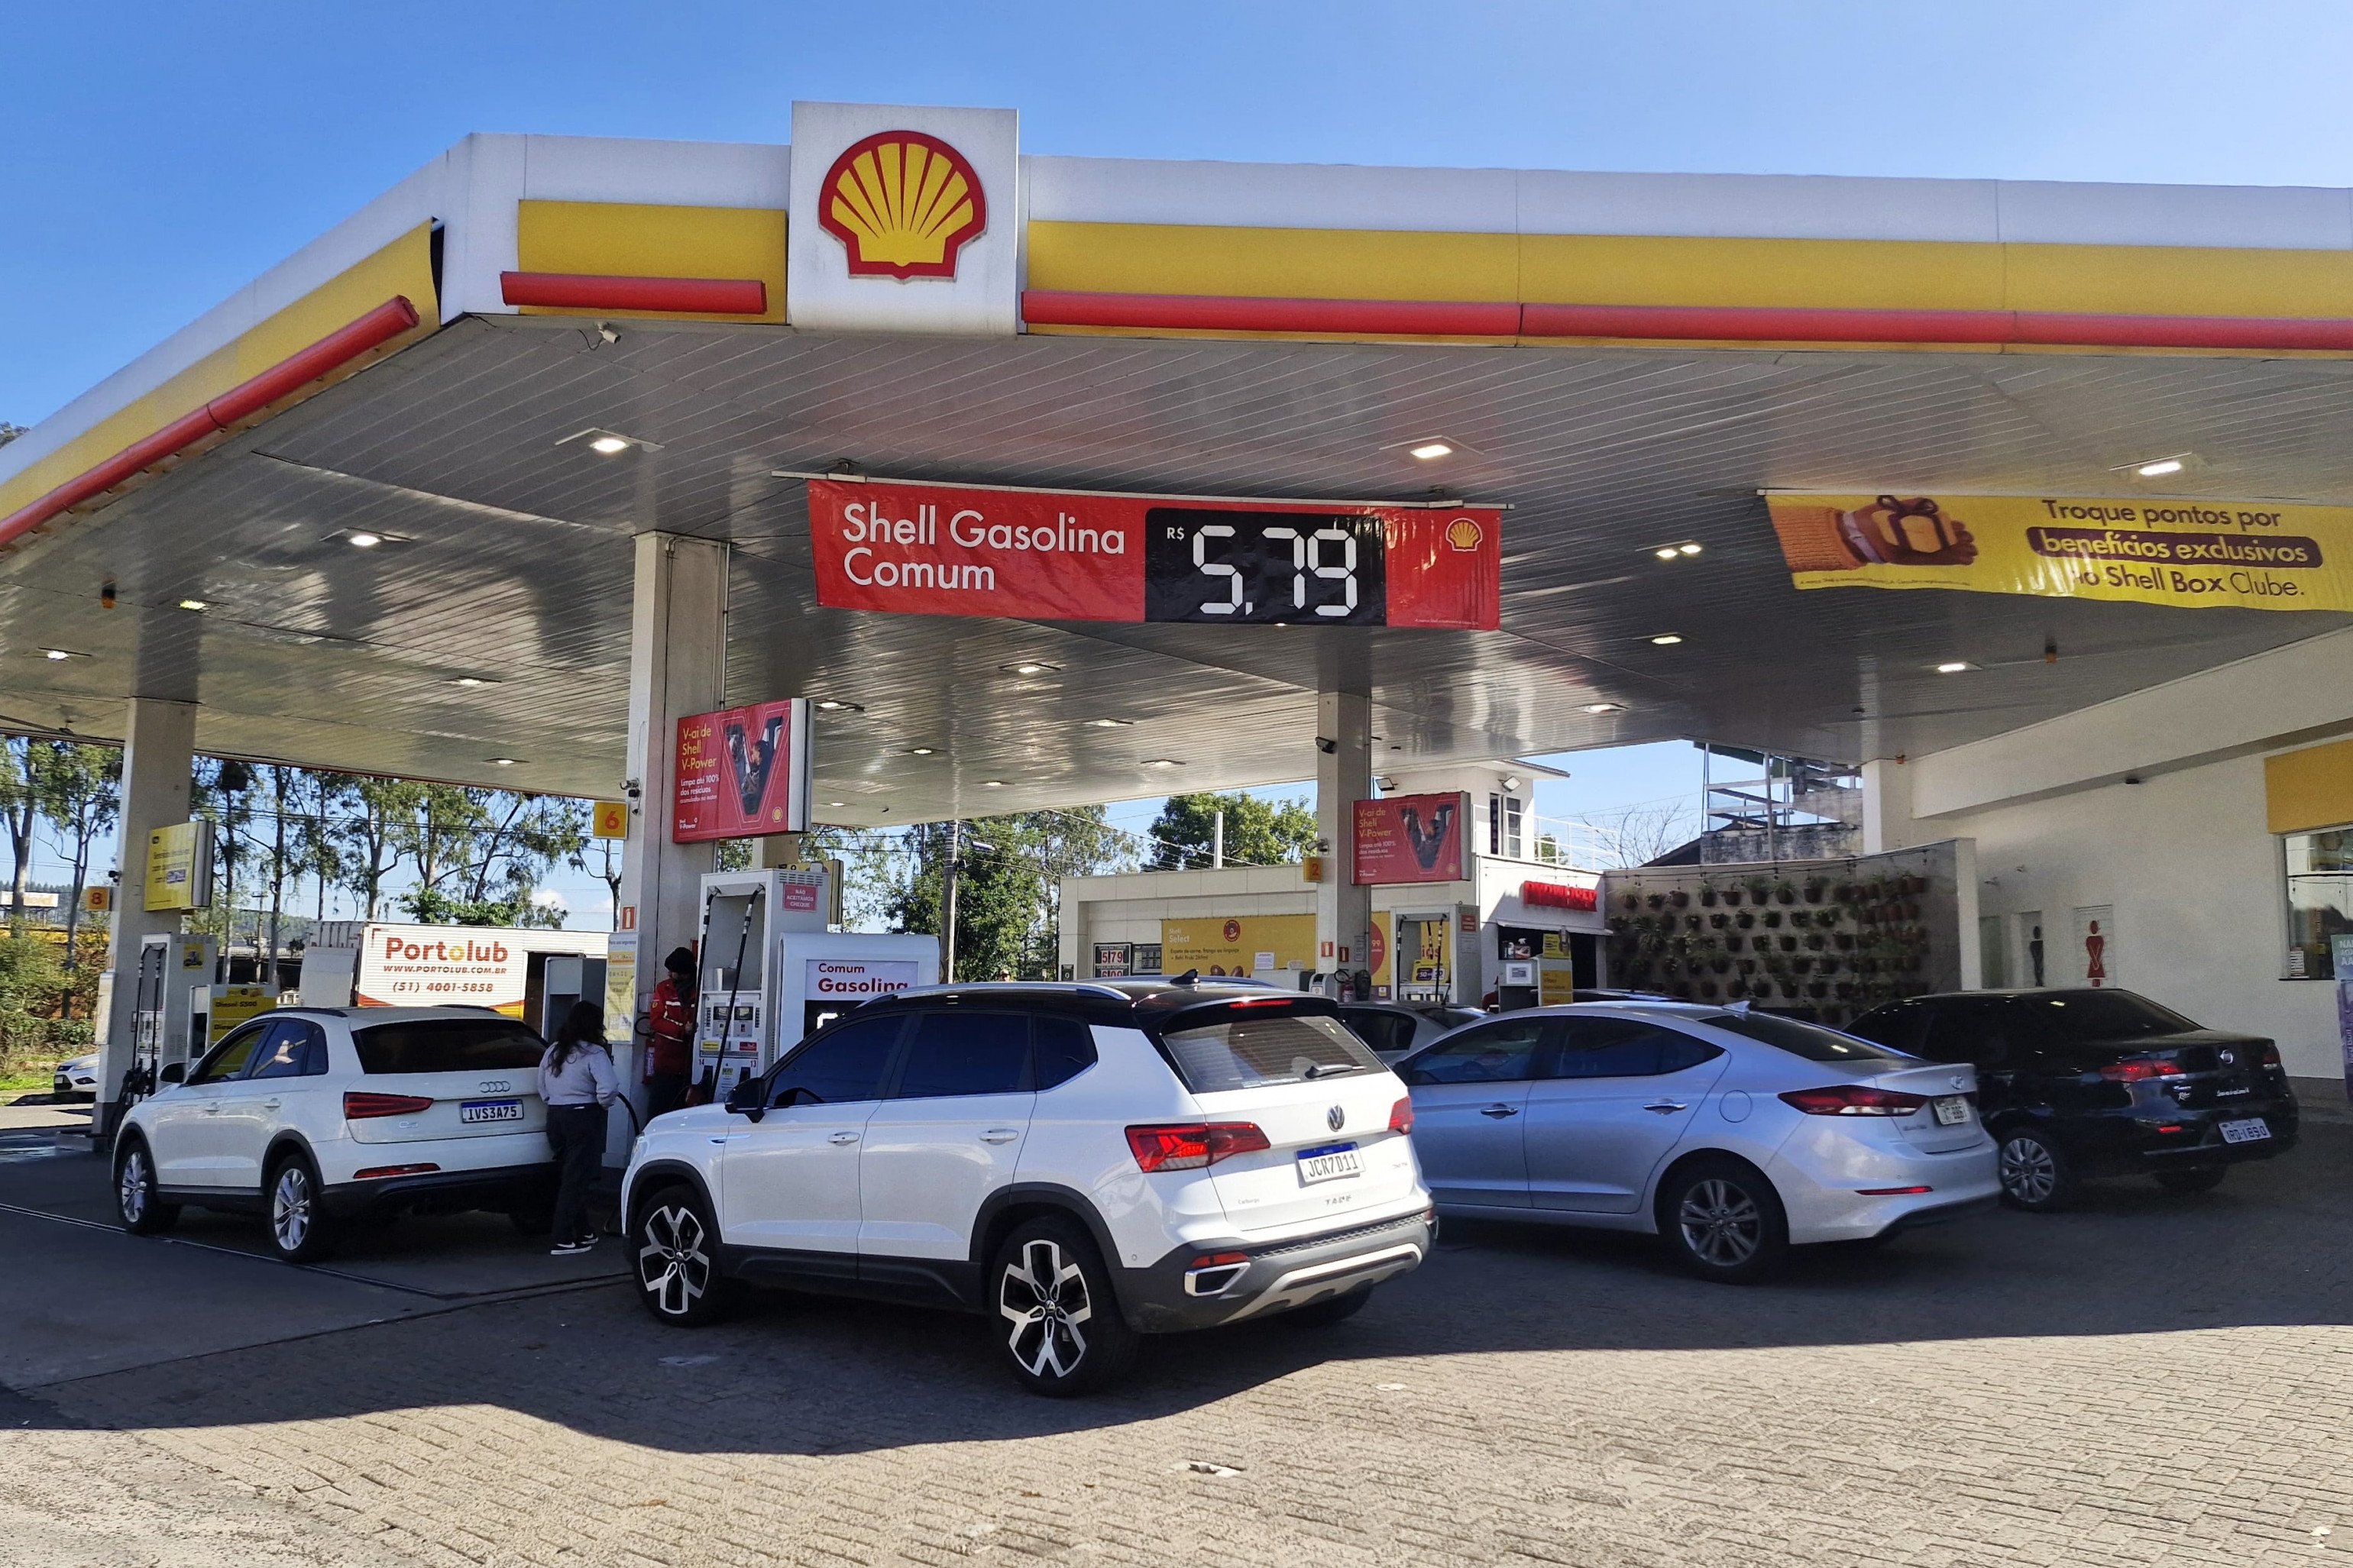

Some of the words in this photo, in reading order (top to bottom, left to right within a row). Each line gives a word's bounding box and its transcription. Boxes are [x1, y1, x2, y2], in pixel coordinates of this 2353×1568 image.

[2042, 499, 2136, 526] Troque
[2143, 506, 2232, 528] pontos
[2238, 511, 2281, 532] por
[843, 501, 936, 545] Shell
[950, 509, 1125, 554] Gasolina
[2039, 529, 2170, 558] benefícios
[2176, 536, 2308, 562] exclusivos
[843, 547, 995, 590] Comum
[1167, 526, 1185, 541] R$
[1193, 525, 1358, 616] 5,79
[2106, 565, 2165, 590] Shell
[2170, 571, 2226, 593] Box
[2230, 571, 2304, 596] Clube.
[701, 723, 711, 737] de
[682, 741, 701, 755] Shell
[682, 758, 717, 771] V-Power
[681, 778, 695, 787] Limpa
[706, 774, 719, 783] 100%
[1376, 807, 1386, 816] de
[605, 810, 620, 829] 6
[1359, 820, 1377, 828] Shell
[1359, 829, 1392, 838] V-Power
[1312, 863, 1319, 875] 2
[92, 892, 102, 905] 8
[1170, 934, 1189, 942] Select
[386, 937, 508, 962] Portolub
[384, 965, 507, 975] WWW.PORTOLUB.COM.BR
[818, 963, 865, 974] Comum
[393, 981, 420, 993] (51)
[426, 982, 494, 992] 4001-5858
[818, 978, 908, 994] Gasolina
[468, 1106, 516, 1120] IVS3A75
[1307, 1153, 1358, 1177] JCR7D11
